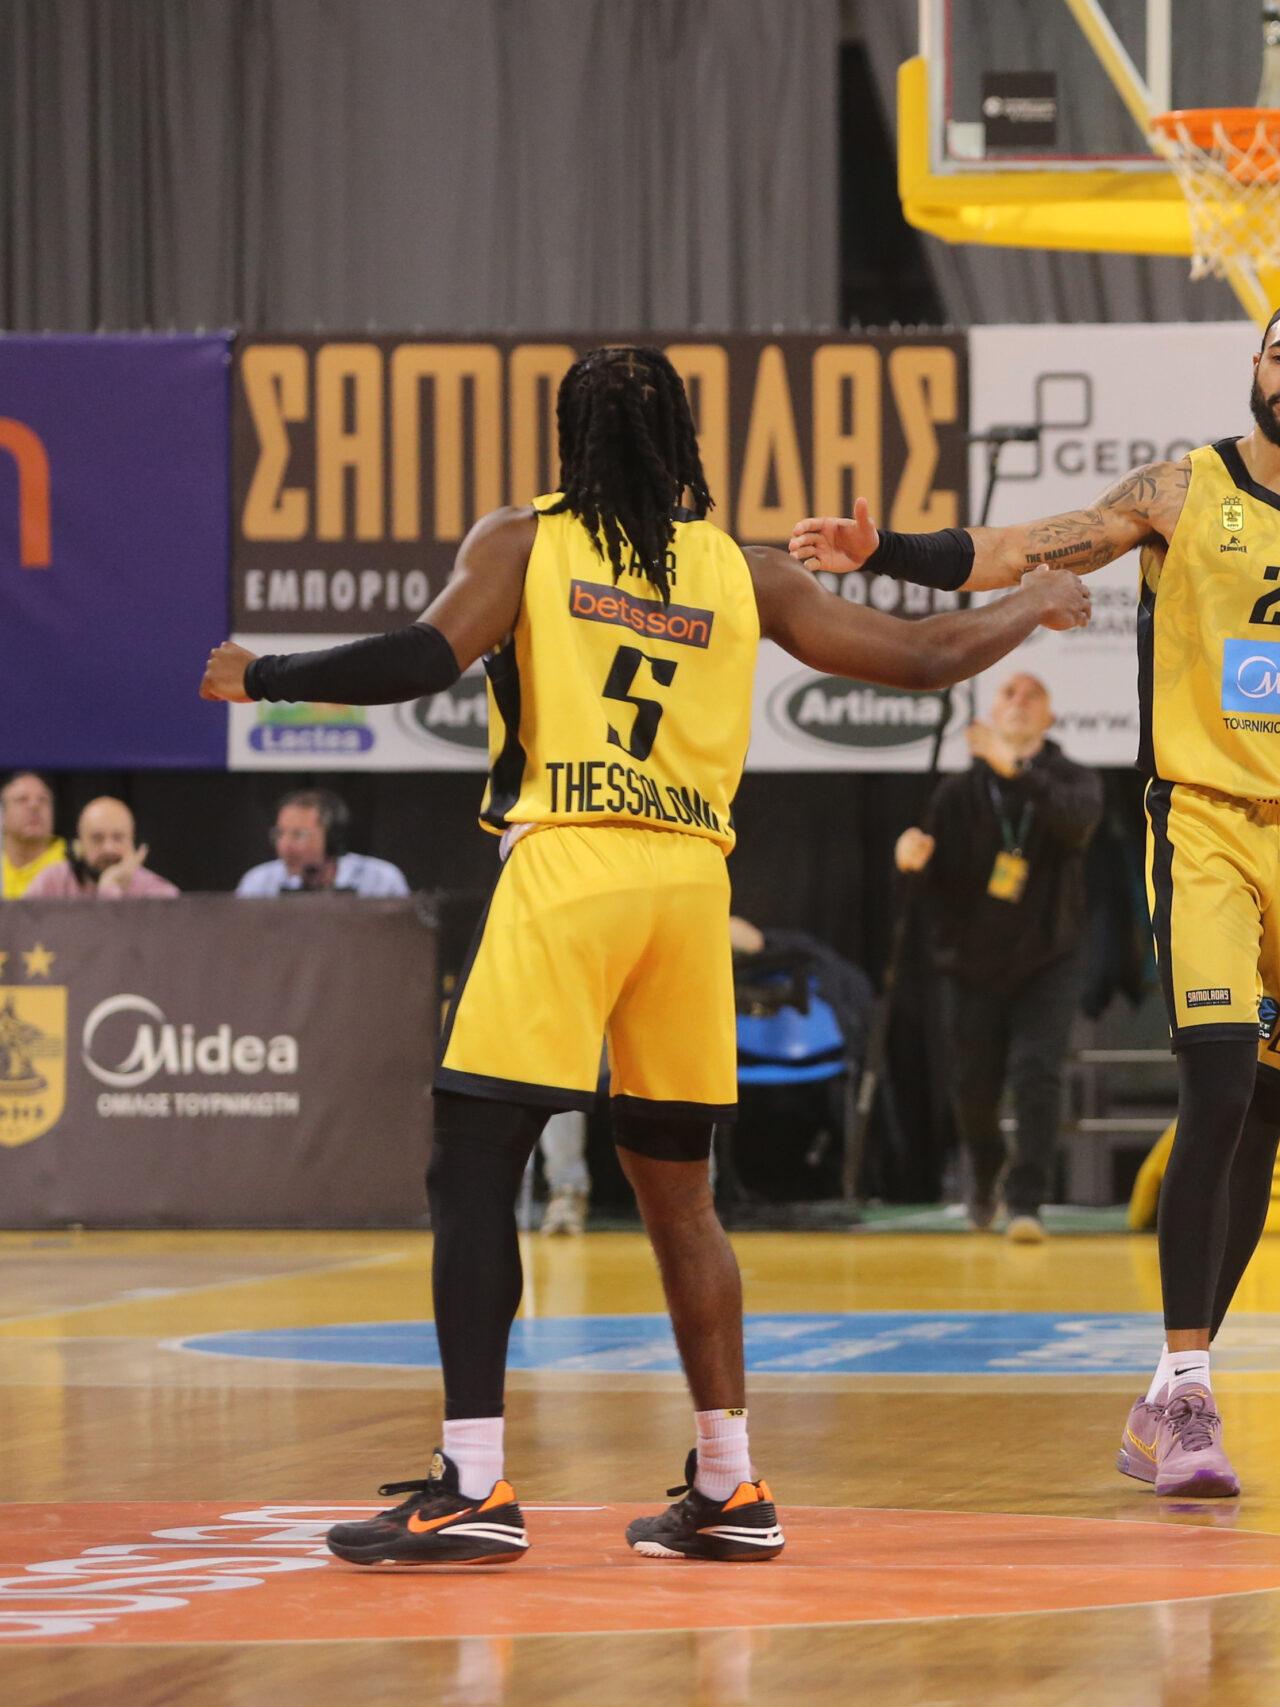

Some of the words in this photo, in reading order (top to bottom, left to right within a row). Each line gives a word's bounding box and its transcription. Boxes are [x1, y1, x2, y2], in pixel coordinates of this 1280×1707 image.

[244, 568, 430, 612] ΕΜΠΟΡΙΟ
[572, 584, 709, 642] betsson
[602, 645, 678, 762] 5
[797, 687, 942, 726] Artima
[118, 1023, 299, 1075] Midea
